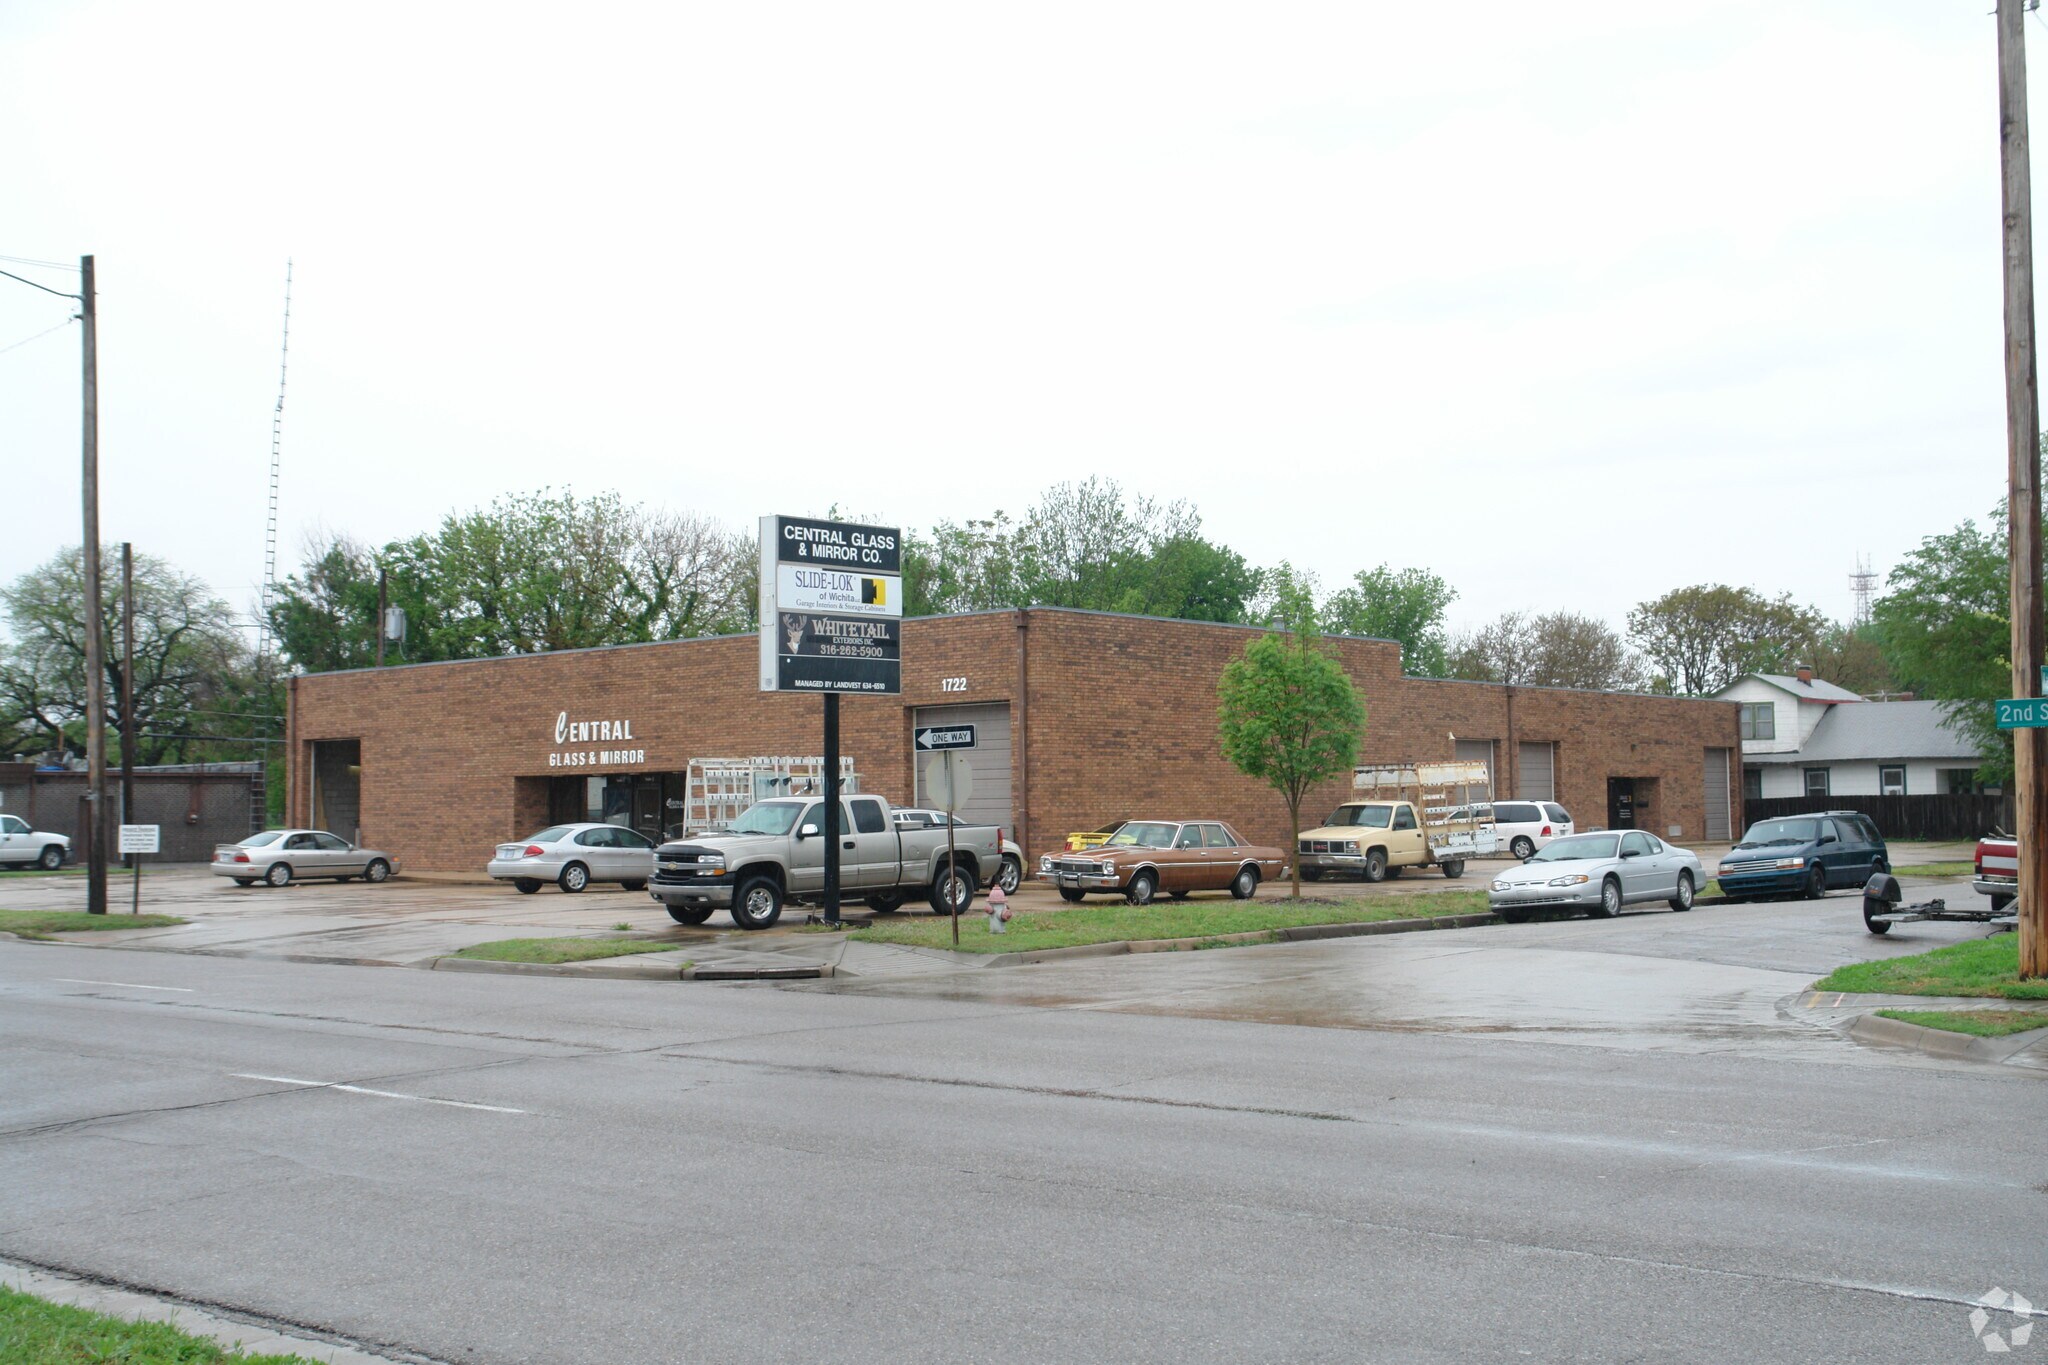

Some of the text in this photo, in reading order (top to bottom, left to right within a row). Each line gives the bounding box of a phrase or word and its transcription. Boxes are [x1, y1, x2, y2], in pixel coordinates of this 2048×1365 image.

[784, 525, 895, 550] CENTRAL GLASS
[798, 542, 882, 563] & MIRROR CO.
[795, 570, 854, 591] SLIDE-LOK
[796, 598, 815, 608] Garage
[816, 600, 838, 609] Interiors
[845, 603, 863, 611] Storage
[819, 592, 827, 600] of
[829, 592, 855, 602] Wichita
[811, 617, 890, 639] WHITETAIL
[832, 636, 874, 646] EXTERIORS INC.
[820, 644, 883, 658] 316-262-5900
[795, 679, 823, 688] MANAGED
[825, 680, 832, 688] BY
[833, 681, 861, 689] LANDVEST
[942, 677, 967, 692] 1722
[2000, 704, 2033, 722] 2nd
[555, 711, 633, 744] CENTRAL
[932, 732, 968, 743] ONE WAY
[549, 749, 644, 766] GLASS & MIRROR
